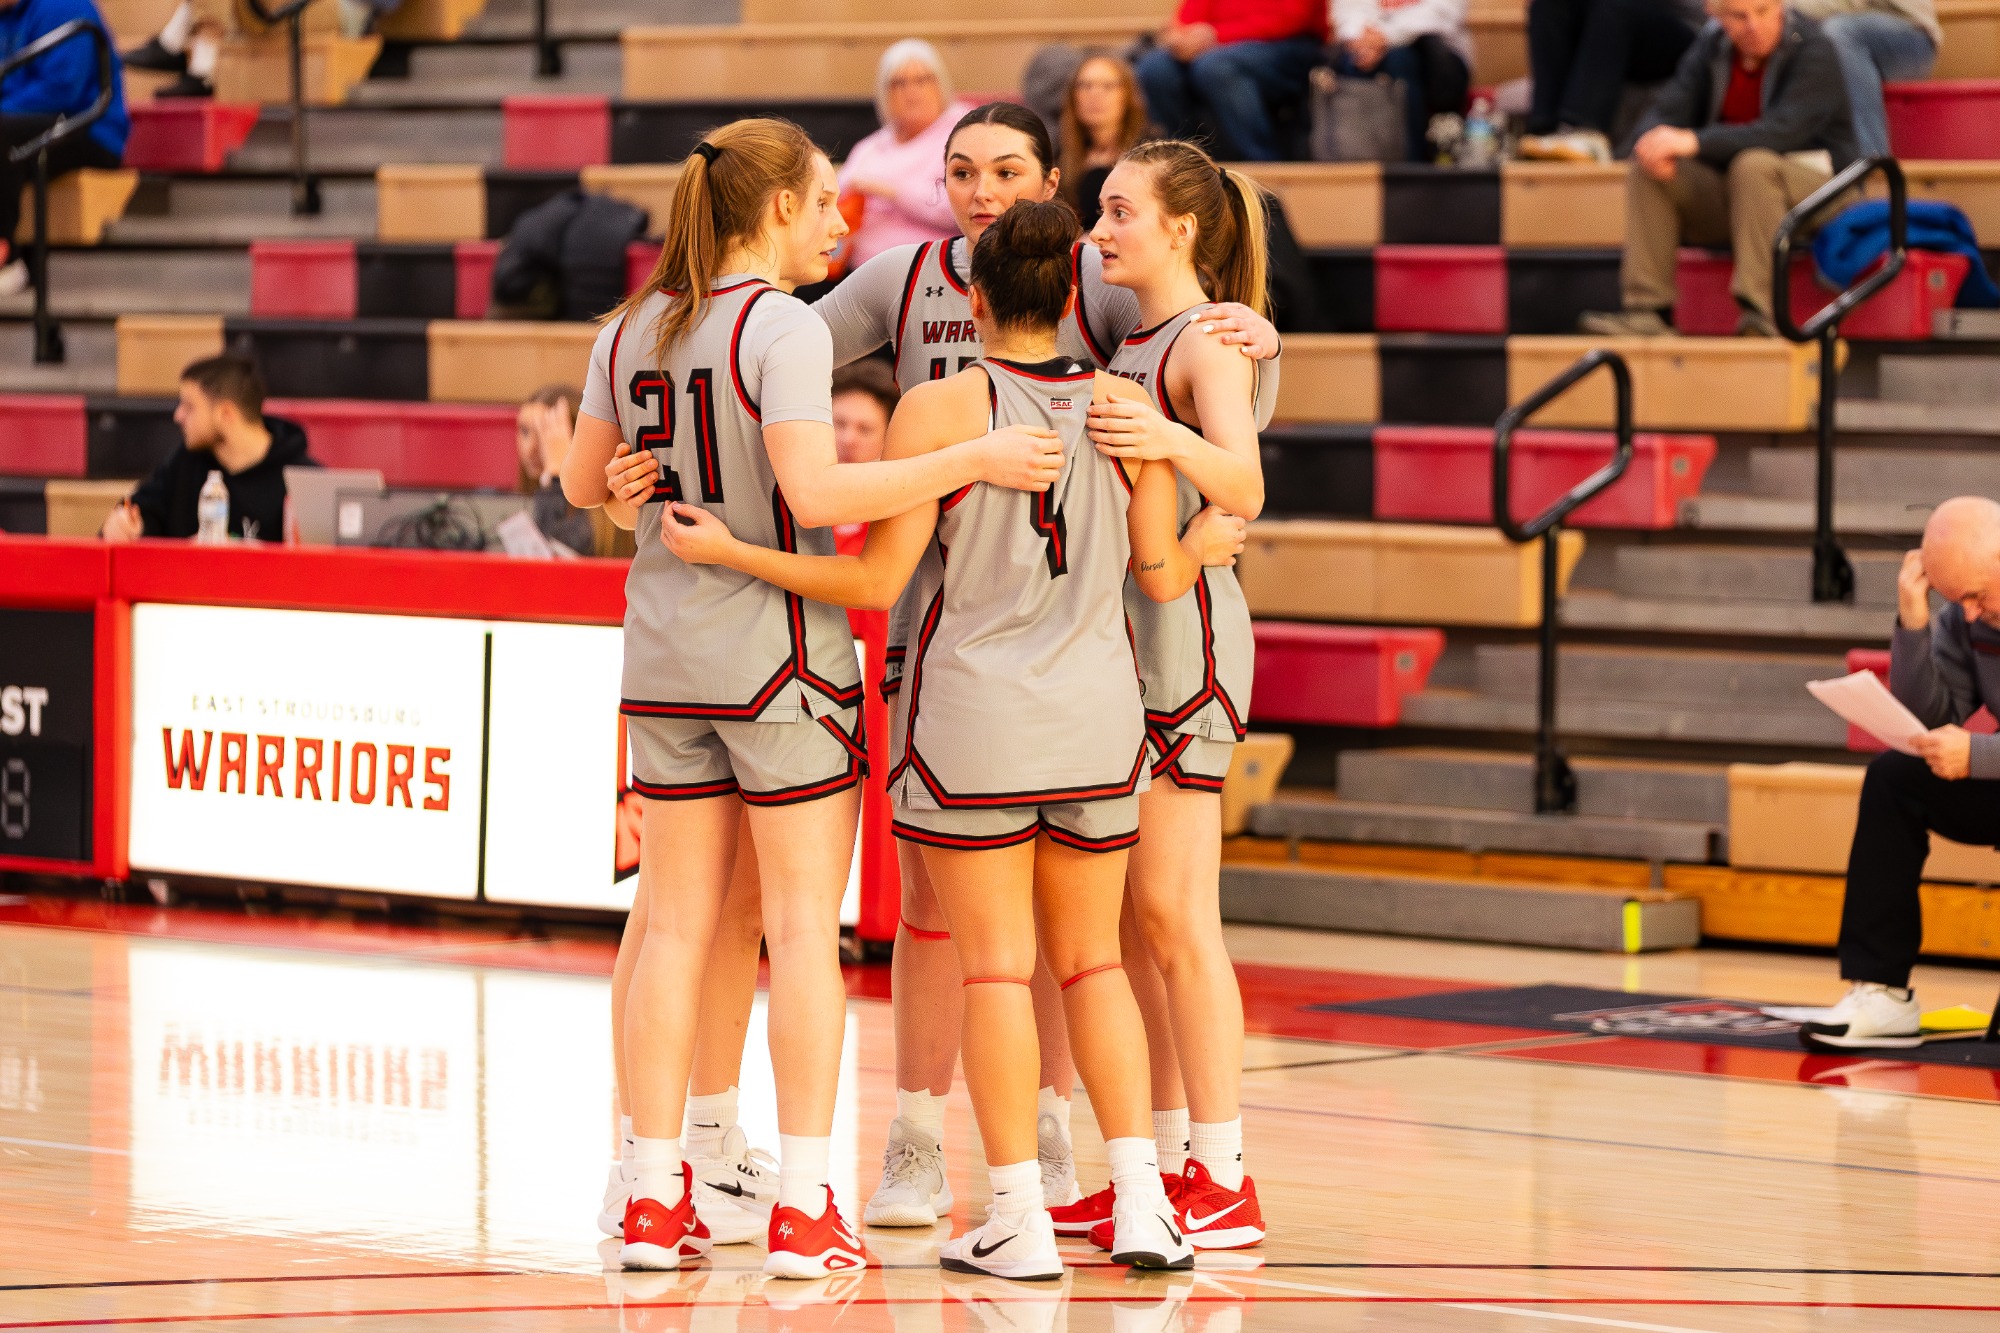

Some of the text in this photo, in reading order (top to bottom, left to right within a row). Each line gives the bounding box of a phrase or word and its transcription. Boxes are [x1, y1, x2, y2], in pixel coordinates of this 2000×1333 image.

[922, 319, 984, 345] WAR
[628, 368, 725, 503] 21
[0, 684, 49, 737] ST
[192, 695, 245, 713] EAST
[162, 727, 451, 812] WARRIORS
